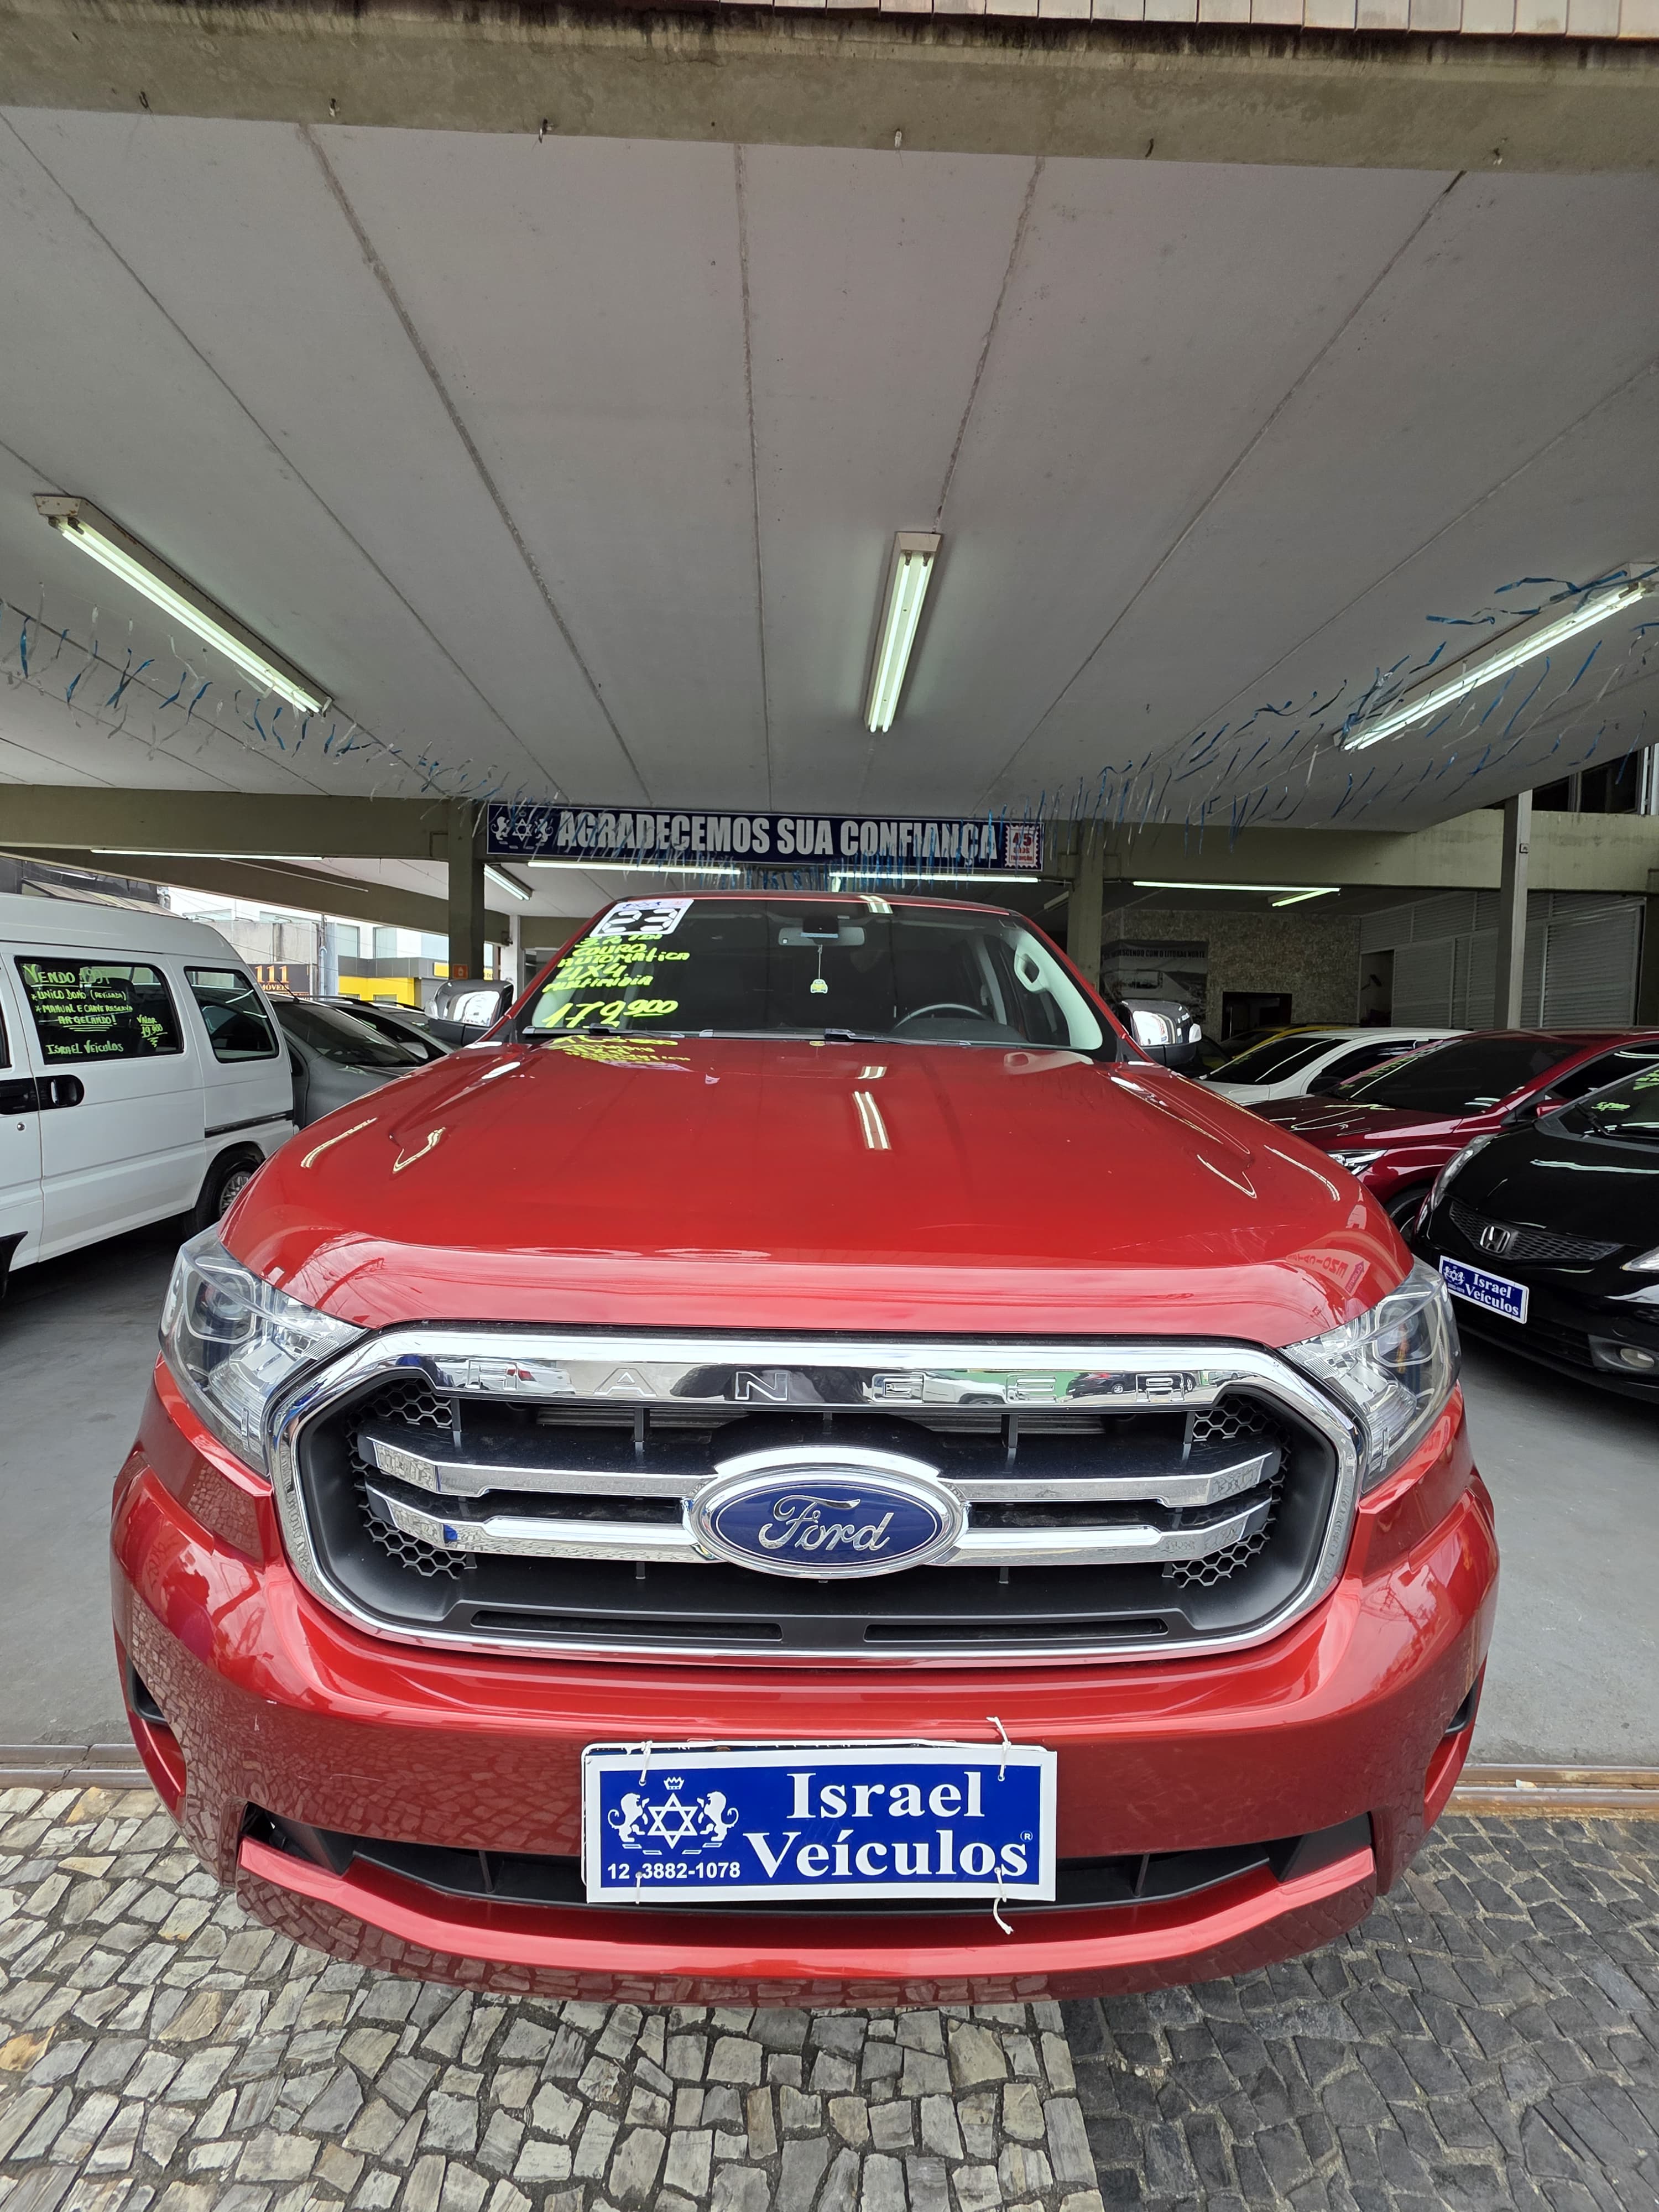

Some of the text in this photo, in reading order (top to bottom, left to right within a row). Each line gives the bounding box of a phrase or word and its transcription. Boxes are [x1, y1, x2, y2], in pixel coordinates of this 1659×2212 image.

[556, 810, 998, 867] AGRADECEMOS SUA CONFIANÇA
[1013, 832, 1032, 846] 45
[602, 908, 678, 933] 23
[22, 964, 75, 984] VENDO
[1465, 1283, 1519, 1316] Veículos
[1473, 1273, 1512, 1298] Israel
[467, 1359, 1185, 1404] RANGER
[758, 1495, 894, 1551] Ford
[786, 1771, 986, 1820] Israel
[608, 1862, 741, 1880] 12 3882-1078
